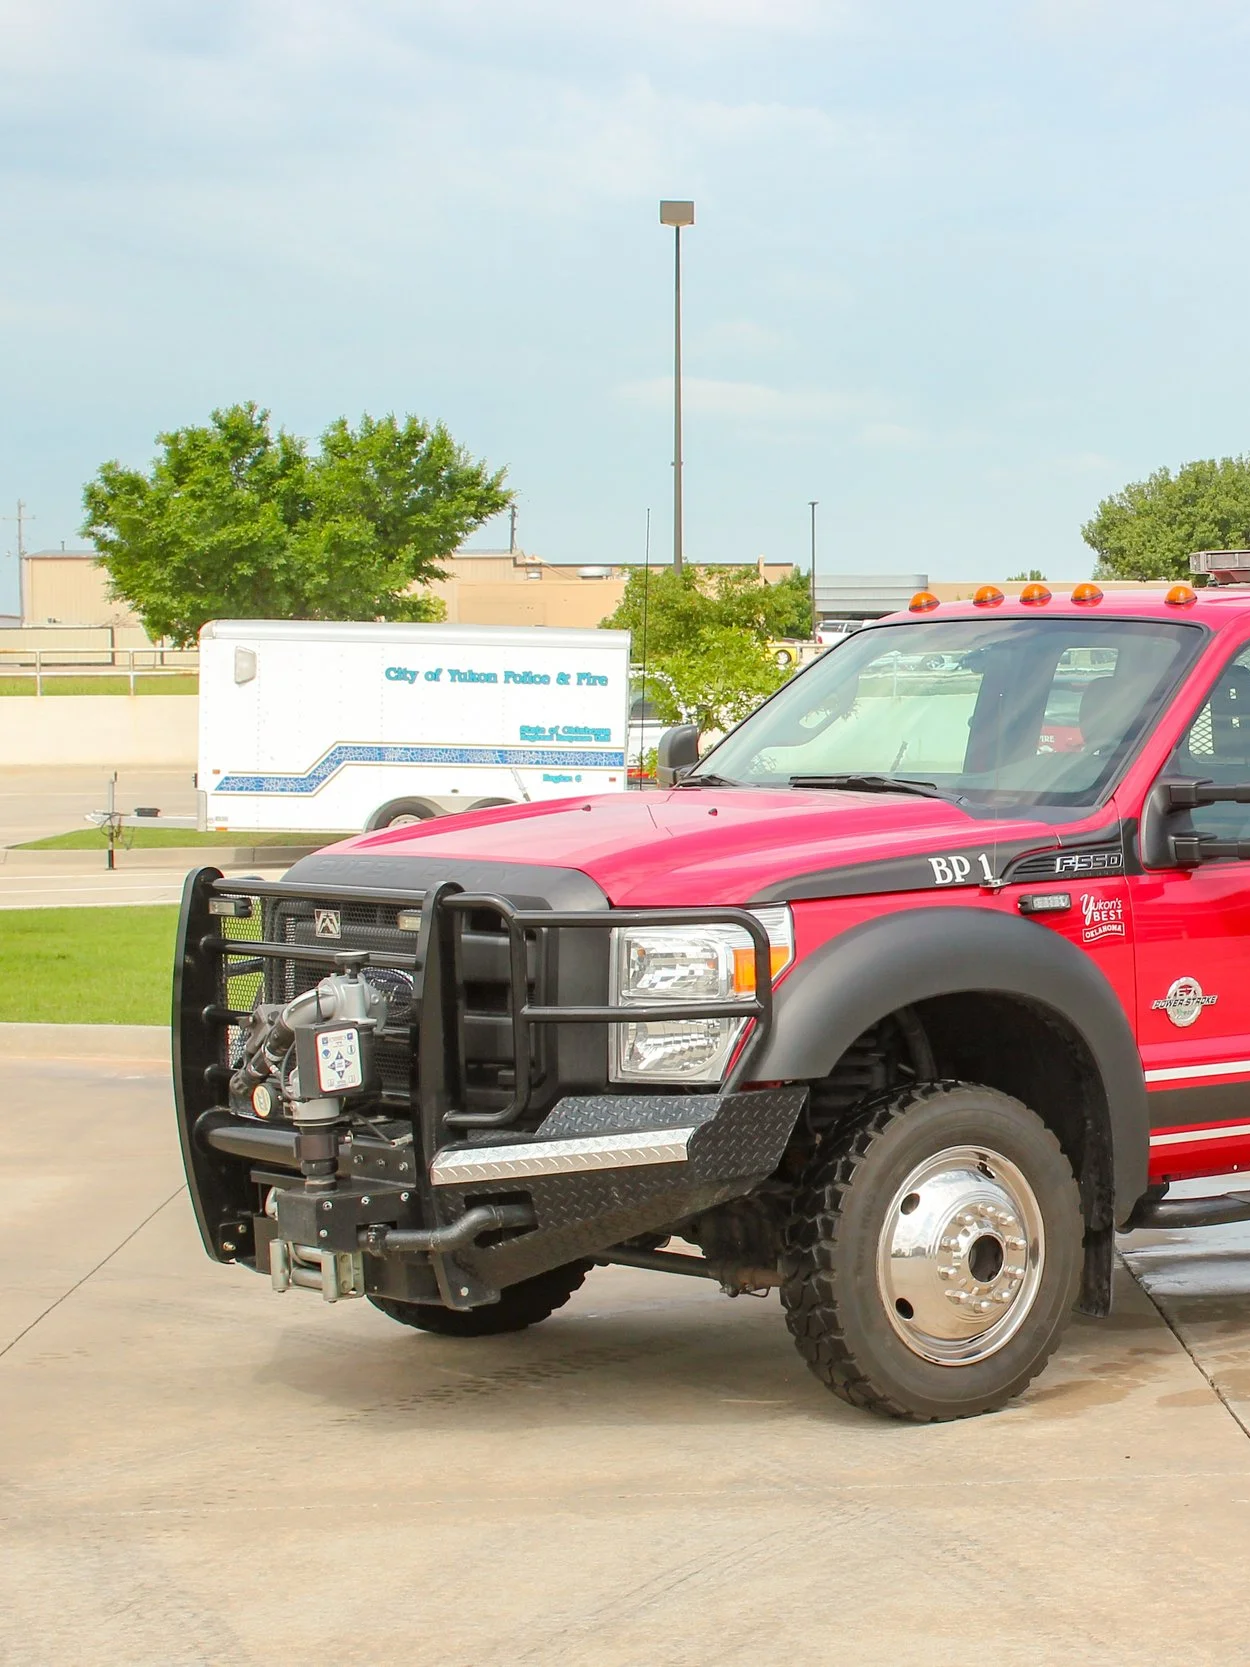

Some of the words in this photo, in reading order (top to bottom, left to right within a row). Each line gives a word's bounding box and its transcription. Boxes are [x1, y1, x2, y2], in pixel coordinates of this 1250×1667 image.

[385, 667, 419, 684] City
[424, 668, 443, 682] of
[448, 669, 498, 684] Yukon
[503, 671, 551, 685] Police
[556, 672, 571, 686] &
[577, 672, 609, 686] Fire
[928, 855, 971, 884] BP
[978, 853, 994, 882] 1
[1055, 853, 1123, 873] F-550
[1080, 893, 1122, 926] Yukon's
[1093, 909, 1123, 922] BEST
[1085, 924, 1122, 939] OKLAHOMA
